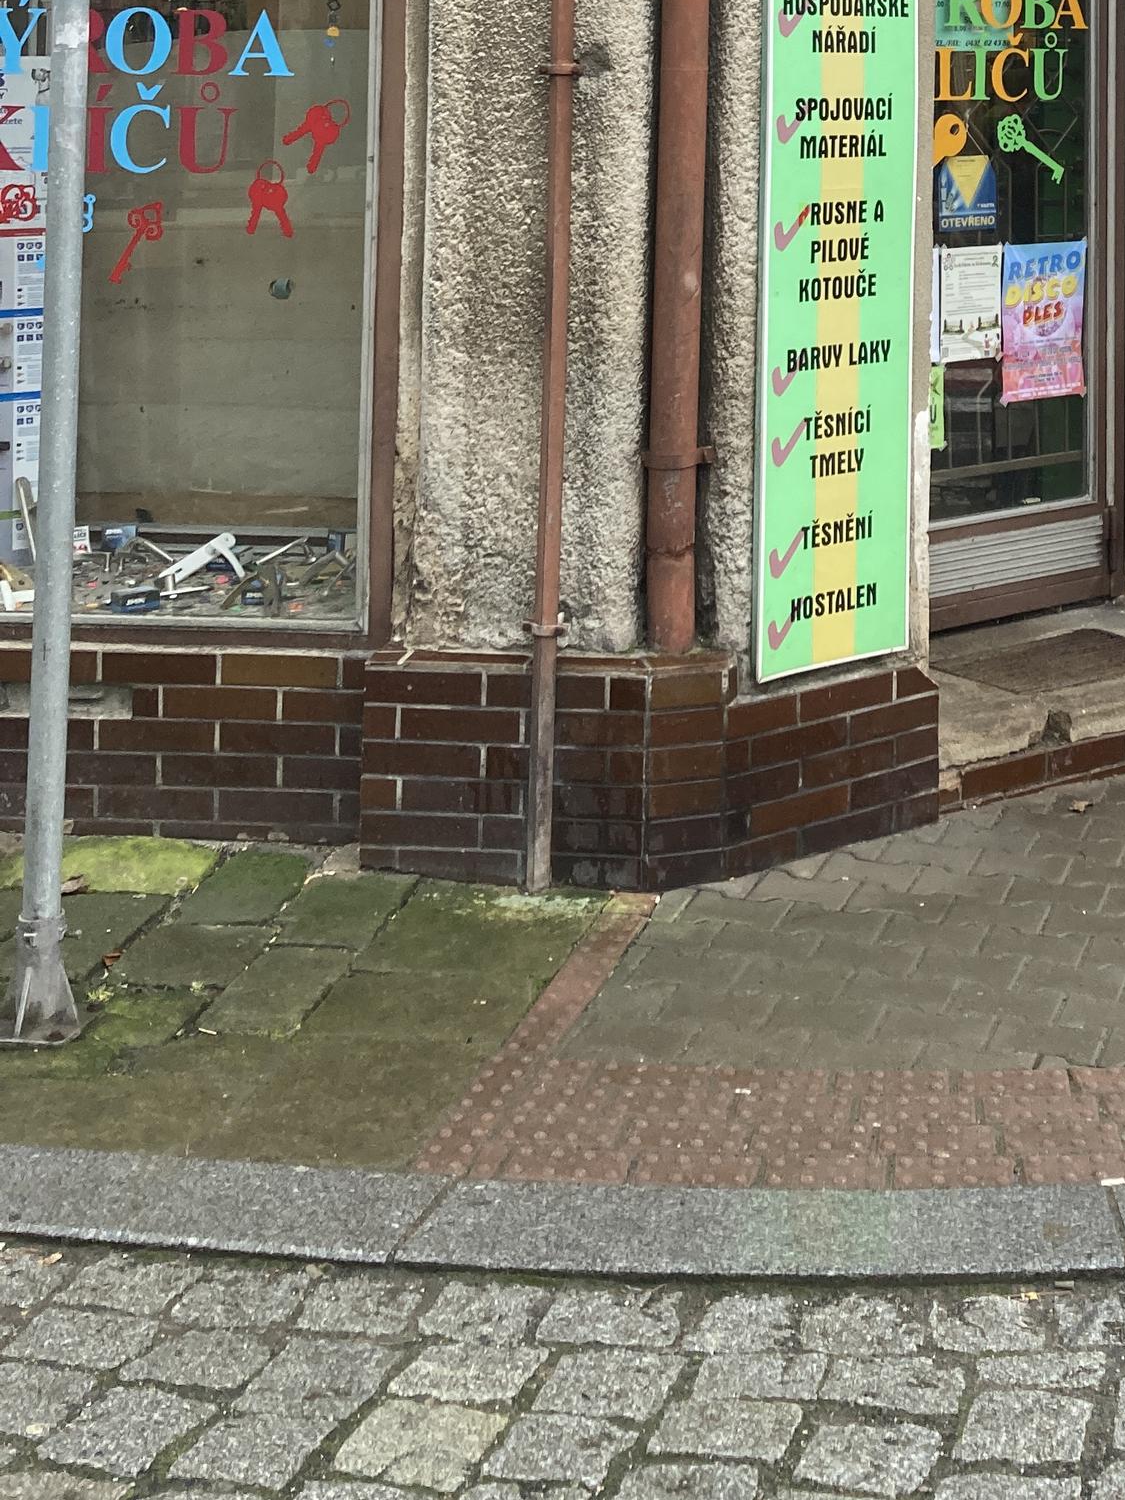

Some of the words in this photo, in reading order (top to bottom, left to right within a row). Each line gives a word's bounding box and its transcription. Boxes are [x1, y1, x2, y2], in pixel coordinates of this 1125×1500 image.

[812, 25, 876, 54] NÁŘADÍ
[795, 93, 893, 122] SPOJOVACÍ
[799, 129, 887, 159] MATERIÁL
[873, 199, 884, 223] A
[941, 214, 995, 229] OTEVŘENO
[810, 232, 869, 264] PILOVÉ
[1007, 250, 1081, 281] RETRO
[799, 268, 877, 303] KOTOUČE
[1004, 275, 1079, 308] DISCO
[787, 343, 843, 373] BARVY
[848, 339, 891, 367] LAKY
[803, 404, 871, 441] TĚSNÍCÍ
[809, 448, 865, 479] TMELY
[801, 510, 873, 550] TĚSNĚNÍ
[790, 582, 877, 623] HOSTALEN
